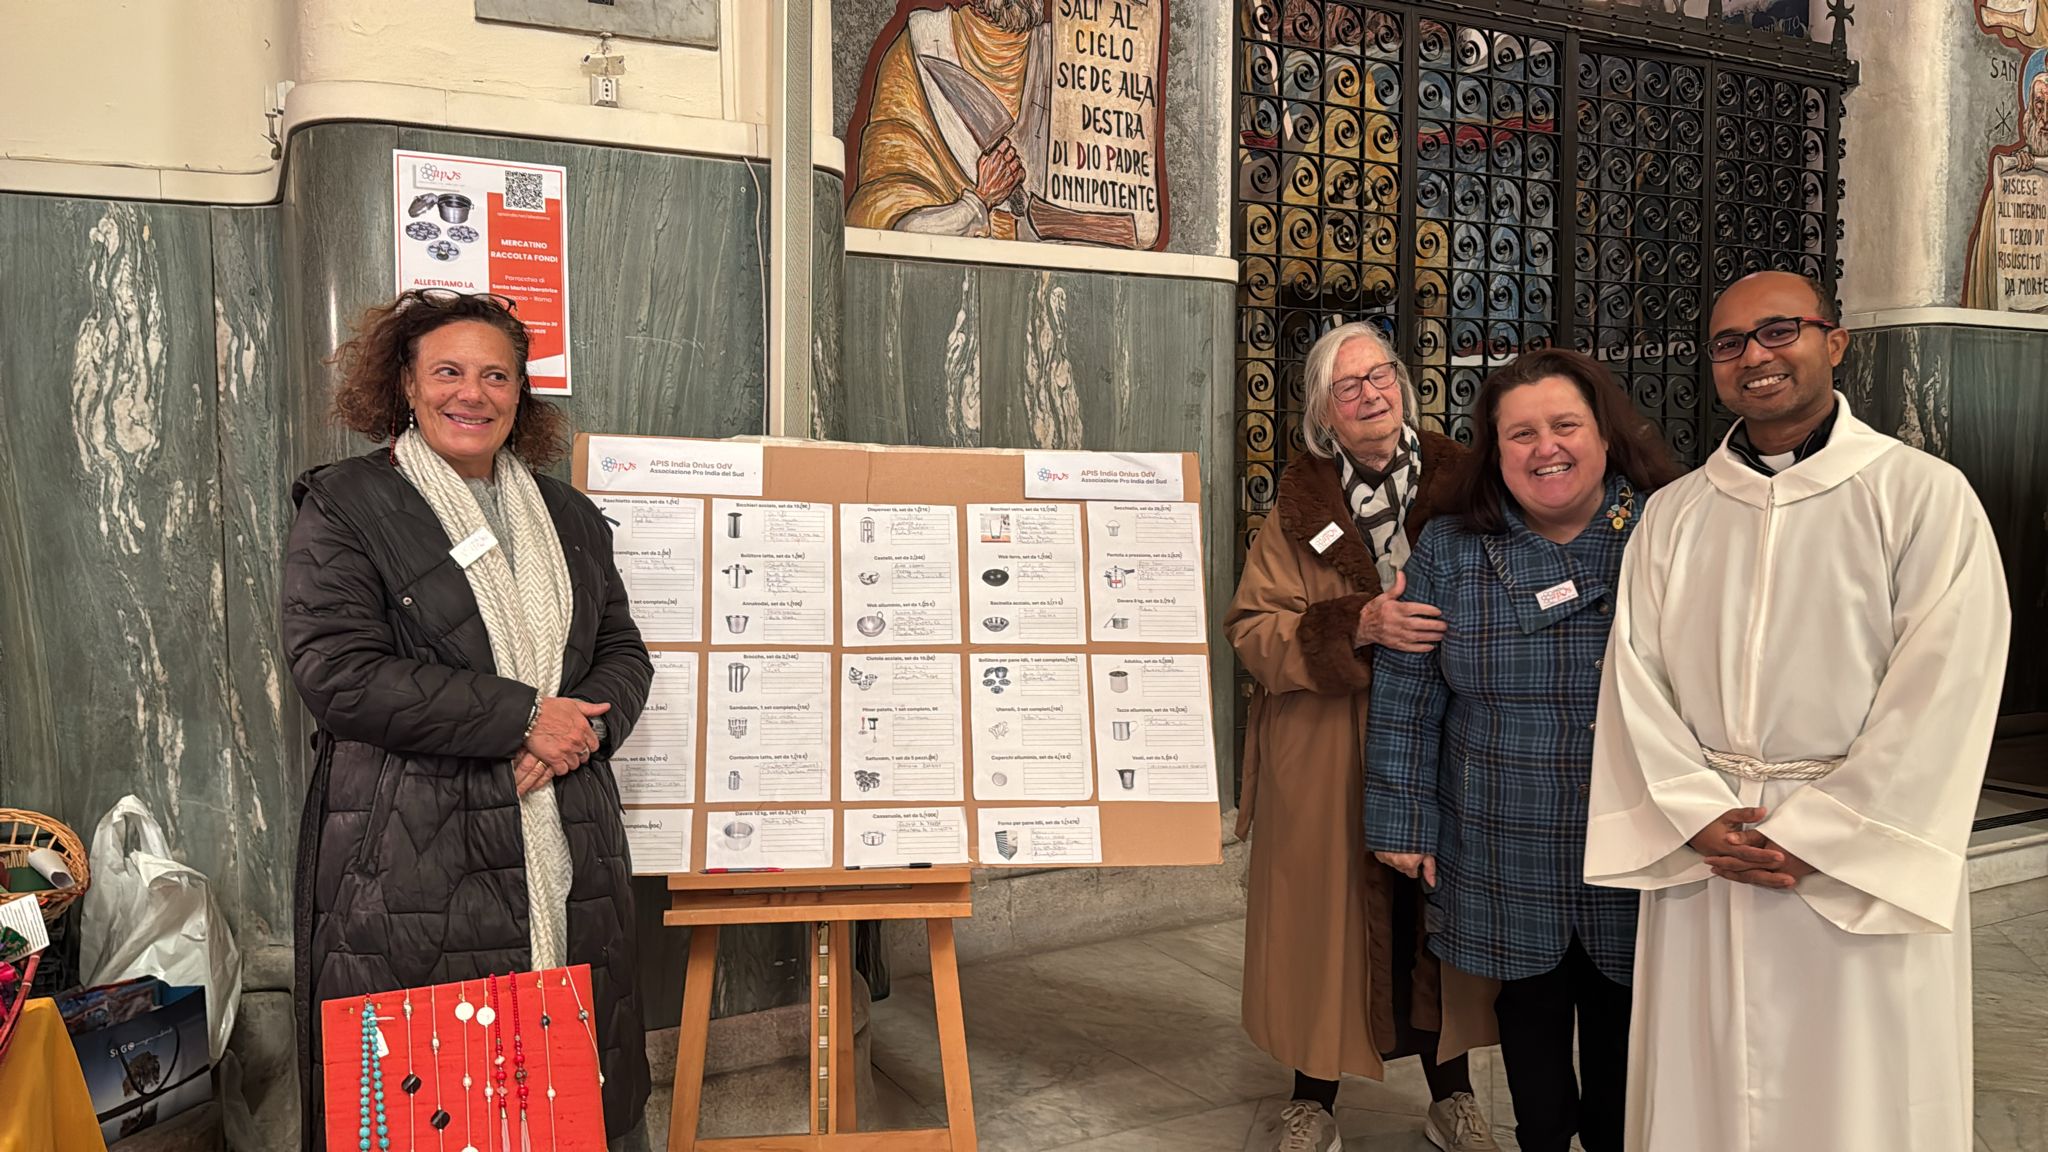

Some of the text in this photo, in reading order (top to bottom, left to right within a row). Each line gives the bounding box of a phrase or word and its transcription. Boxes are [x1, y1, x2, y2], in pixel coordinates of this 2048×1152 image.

[1108, 2, 1138, 31] AL
[1076, 29, 1133, 63] CIELO
[1990, 58, 2017, 82] SAN
[1057, 62, 1156, 110] SIEDE ALLA
[1082, 104, 1145, 140] DESTRA
[1053, 141, 1149, 177] DI DIO PADRE
[1051, 174, 1156, 213] ONNIPOTENTE
[2002, 178, 2038, 196] DISCESE
[501, 239, 547, 250] MERCATINO
[2000, 228, 2007, 244] IL
[2010, 228, 2032, 246] TERZO
[490, 251, 558, 263] RACCOLTA FONDI
[414, 278, 474, 289] ALLESTIAMO LA
[505, 275, 538, 283] Parrocchia
[2004, 277, 2016, 296] DA
